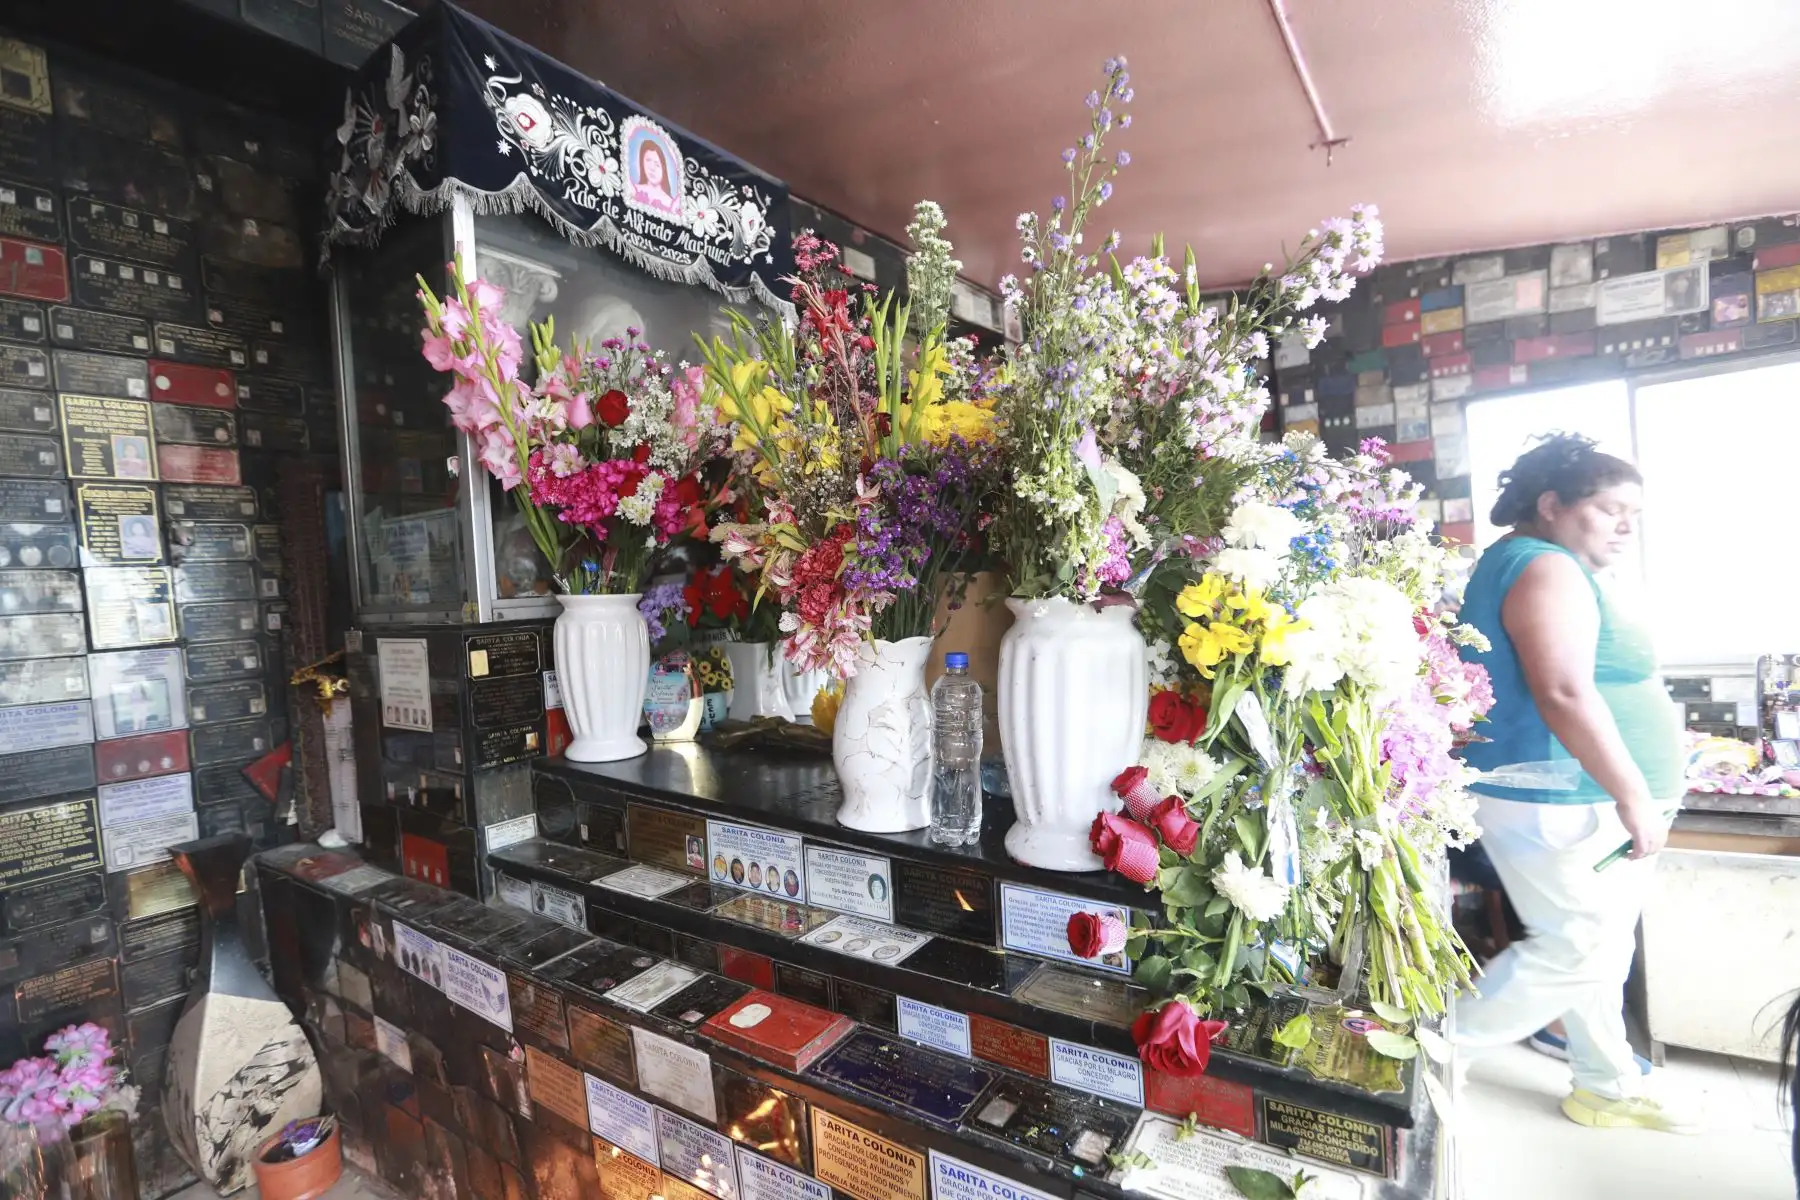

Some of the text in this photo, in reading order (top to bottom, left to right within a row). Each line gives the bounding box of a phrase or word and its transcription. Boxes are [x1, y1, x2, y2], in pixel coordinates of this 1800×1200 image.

[562, 177, 732, 267] Rdo. de Alfredo Machuca
[721, 827, 785, 844] SARITA COLONIA
[818, 853, 867, 867] SARITA COLONIA
[878, 926, 918, 940] COLONIA
[448, 952, 499, 983] SARITA COLONIA
[902, 1002, 963, 1024] SARITA COLONIA
[669, 1051, 701, 1073] COLONIA
[1056, 1045, 1136, 1071] SARITA COLONIA
[1057, 1054, 1083, 1067] GRACIAS
[1084, 1061, 1097, 1070] POR
[1107, 1067, 1137, 1081] MILAGRO
[1077, 1068, 1114, 1083] CONCEDIDO
[591, 1081, 615, 1098] SARITA
[616, 1094, 647, 1114] COLONIA
[662, 1114, 722, 1148] SARITA COLONIA
[1269, 1101, 1377, 1137] SARITA COLONIA
[1281, 1114, 1366, 1144] GRACIAS POR EL
[820, 1117, 916, 1168] SARITA COLONIA
[1270, 1120, 1379, 1157] MILAGRO CONCEDIDO
[1299, 1137, 1311, 1146] TU
[623, 1155, 656, 1177] COLONIA
[818, 1148, 859, 1173] PROTEGENOS
[860, 1167, 869, 1177] EN
[870, 1171, 888, 1187] TODO
[824, 1131, 913, 1178] GRACIAS POR LOS MILAGROS
[1243, 1151, 1291, 1169] COLONIA
[743, 1156, 777, 1178] SARITA
[779, 1172, 823, 1198] COLONIA
[820, 1169, 848, 1186] FAMILIA
[847, 1172, 892, 1198] TUS DEVOTOS
[869, 1162, 904, 1185] AYUDANOS
[905, 1179, 910, 1187] Y
[939, 1164, 988, 1191] SARITA
[941, 1177, 975, 1196] GRACIAS
[940, 1186, 955, 1196] QUE
